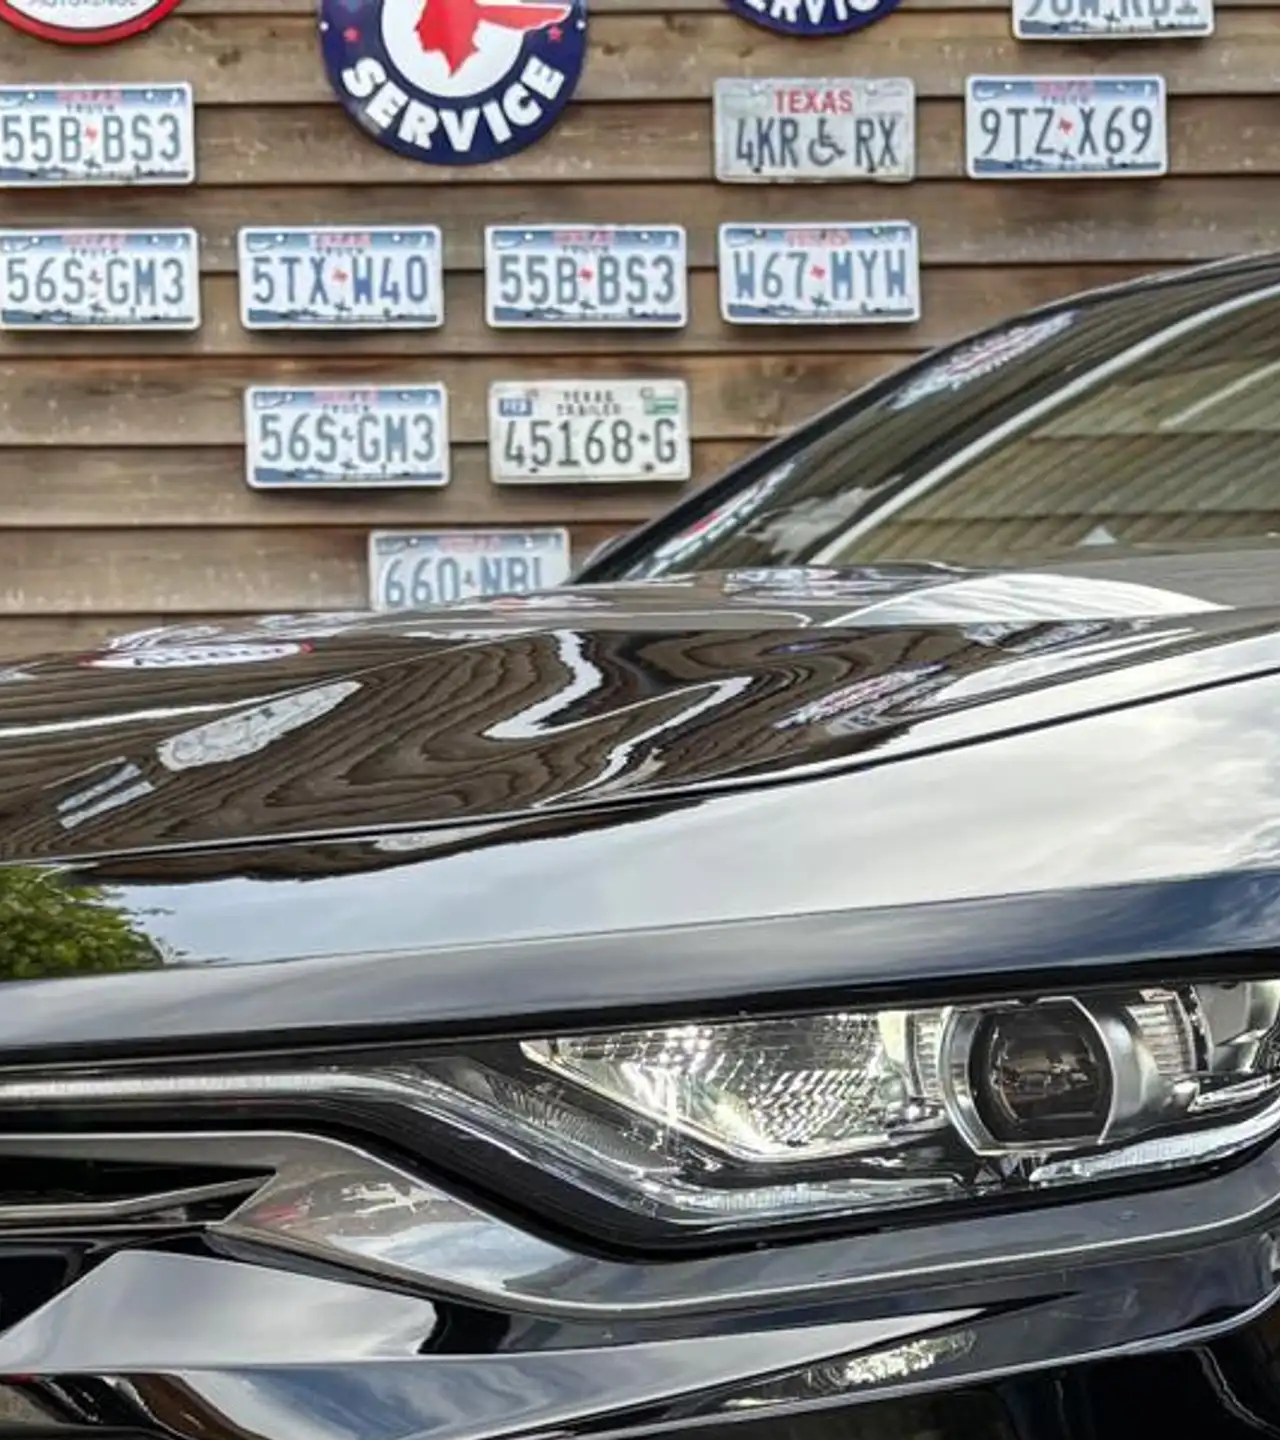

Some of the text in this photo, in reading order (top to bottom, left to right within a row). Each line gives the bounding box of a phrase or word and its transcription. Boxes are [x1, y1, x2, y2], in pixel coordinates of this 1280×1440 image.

[341, 55, 565, 152] SERVICE
[773, 88, 854, 114] TEXAS
[735, 117, 899, 169] 4KR RX
